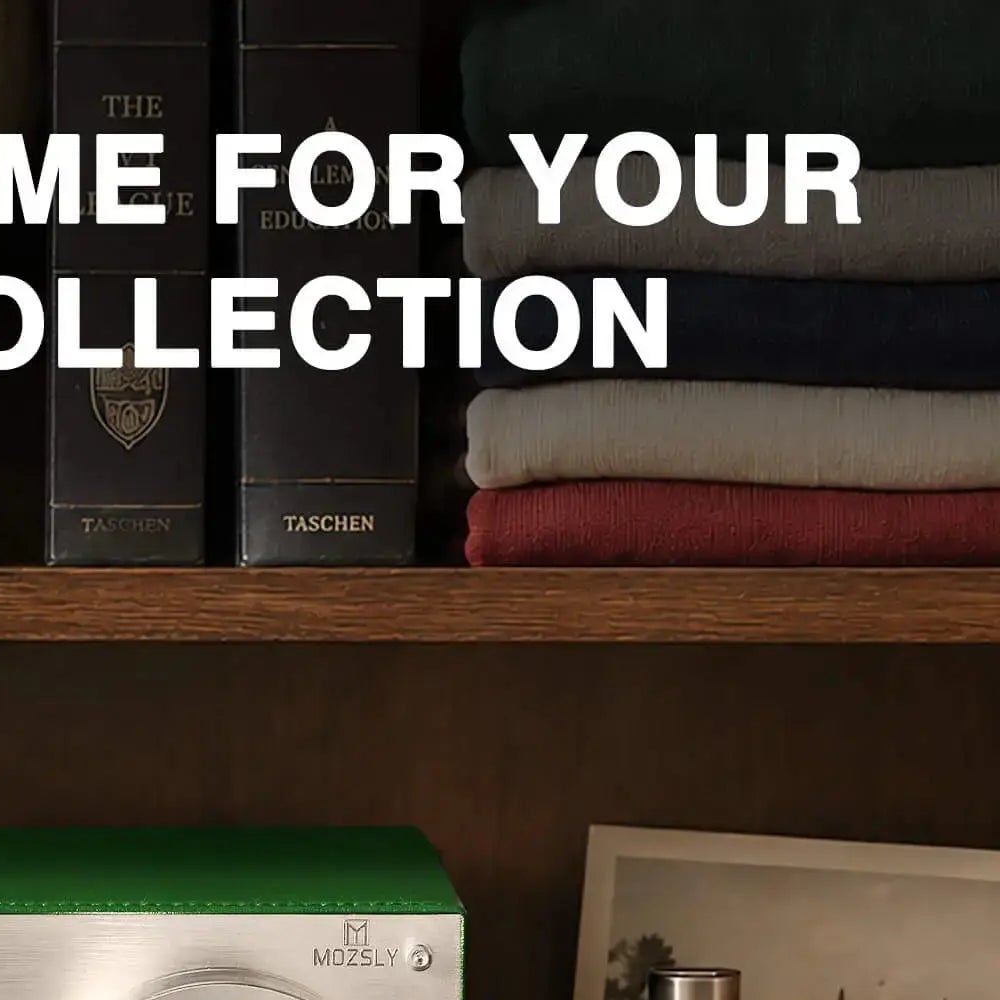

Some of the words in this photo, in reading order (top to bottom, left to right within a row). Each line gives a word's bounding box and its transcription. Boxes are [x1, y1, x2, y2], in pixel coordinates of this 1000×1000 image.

[102, 94, 163, 118] THE
[81, 517, 171, 533] TASCHEN
[284, 515, 375, 532] TASCHEN
[313, 948, 398, 966] MOZSLY
